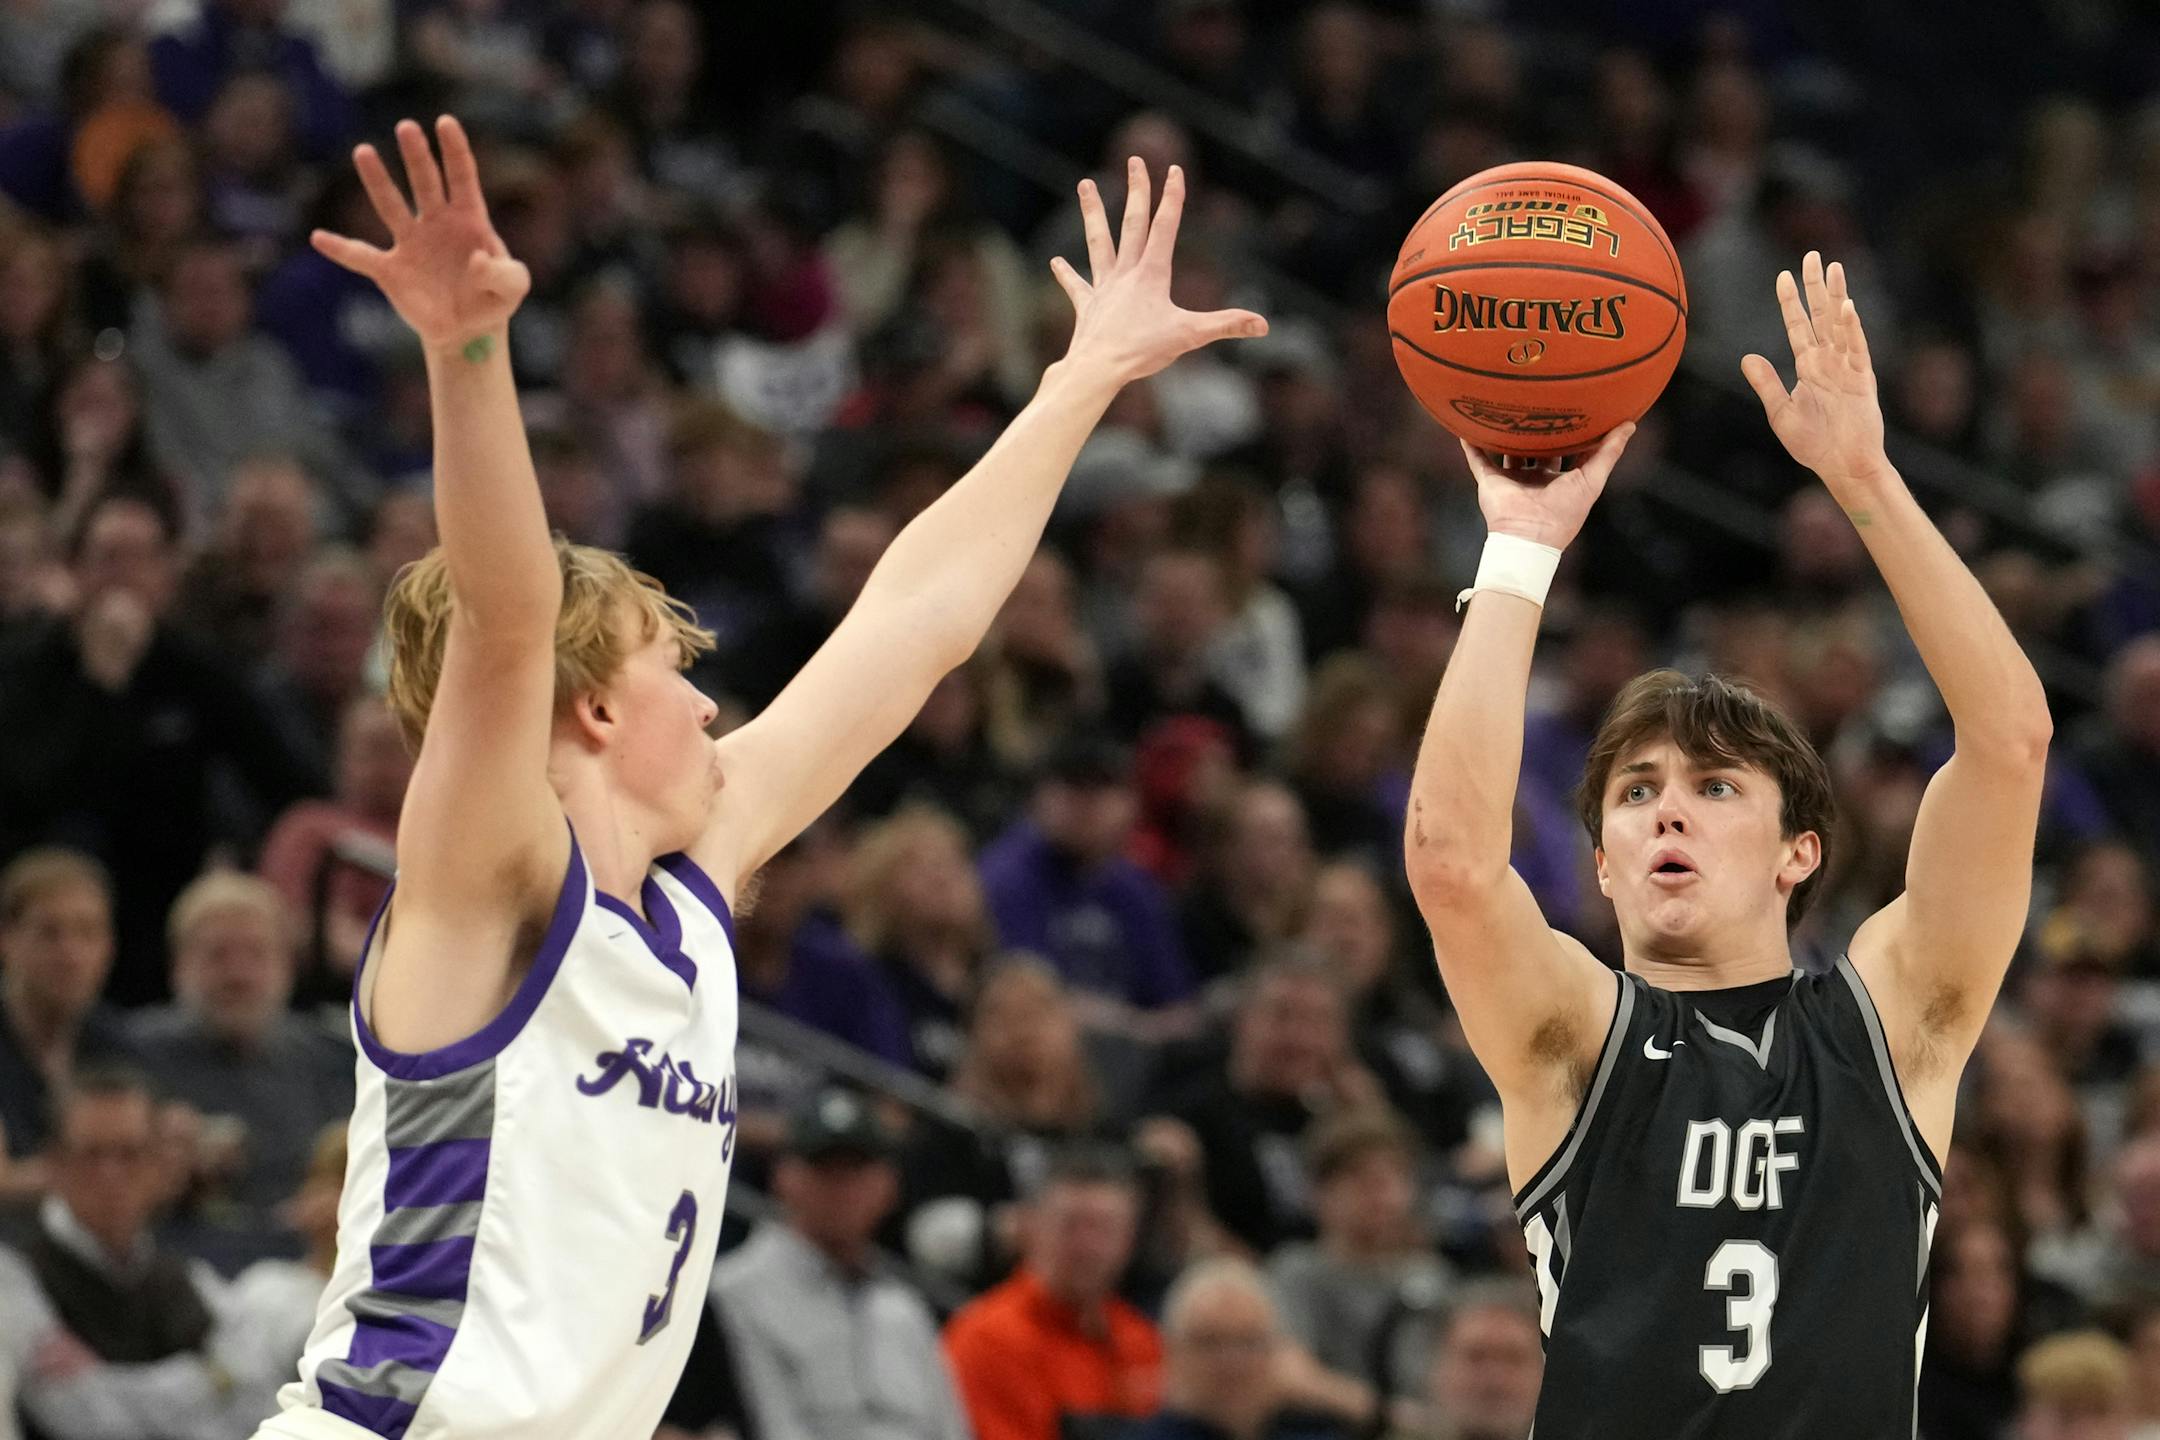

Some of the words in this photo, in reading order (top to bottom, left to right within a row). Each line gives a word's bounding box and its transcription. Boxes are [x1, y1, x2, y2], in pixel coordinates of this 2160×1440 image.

[1450, 214, 1620, 258] LEGACY
[1433, 283, 1627, 340] SPALDING
[1675, 1115, 1805, 1211] DGF
[636, 1189, 698, 1346] 3
[1699, 1238, 1781, 1394] 3
